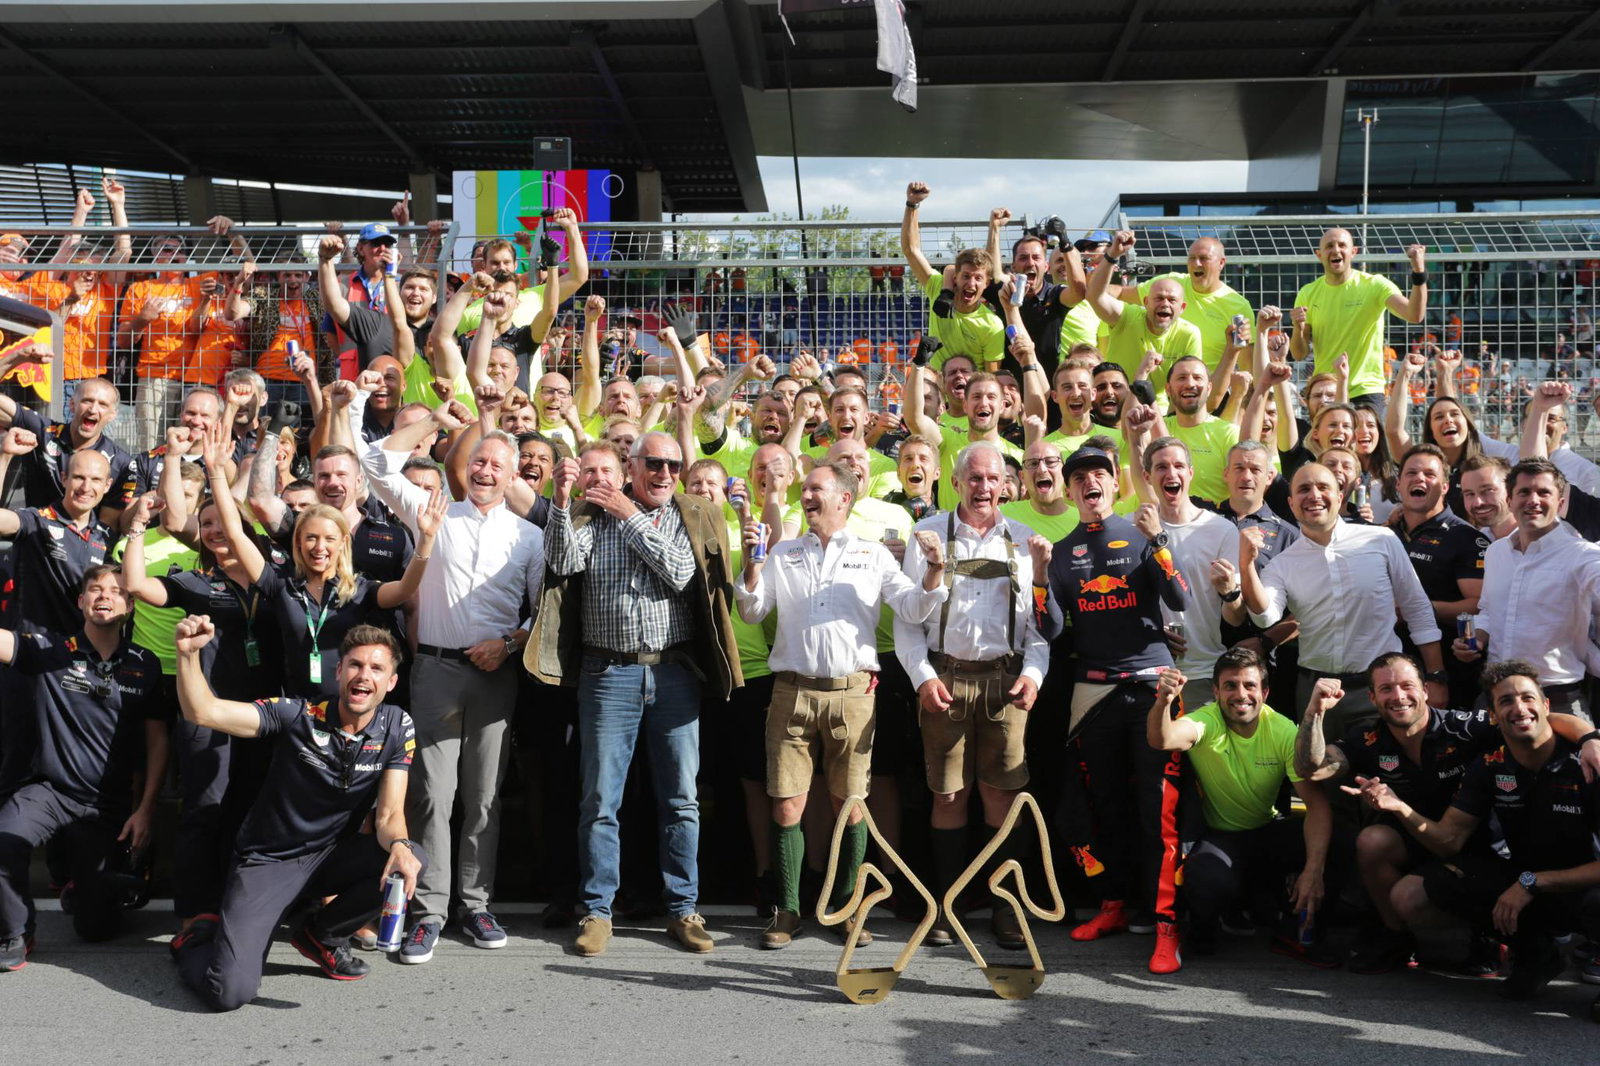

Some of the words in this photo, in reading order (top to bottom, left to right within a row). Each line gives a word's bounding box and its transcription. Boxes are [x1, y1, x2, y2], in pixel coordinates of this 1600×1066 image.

[368, 547, 387, 557] Mobil
[842, 562, 862, 570] Mobil
[1106, 557, 1125, 567] Mobil
[1077, 596, 1106, 613] Red
[1107, 591, 1137, 610] Bull
[118, 684, 136, 695] Mobil
[354, 763, 375, 772] Mobil
[1163, 751, 1182, 777] Re
[1438, 766, 1460, 780] Mobil
[1552, 803, 1576, 814] Mobil
